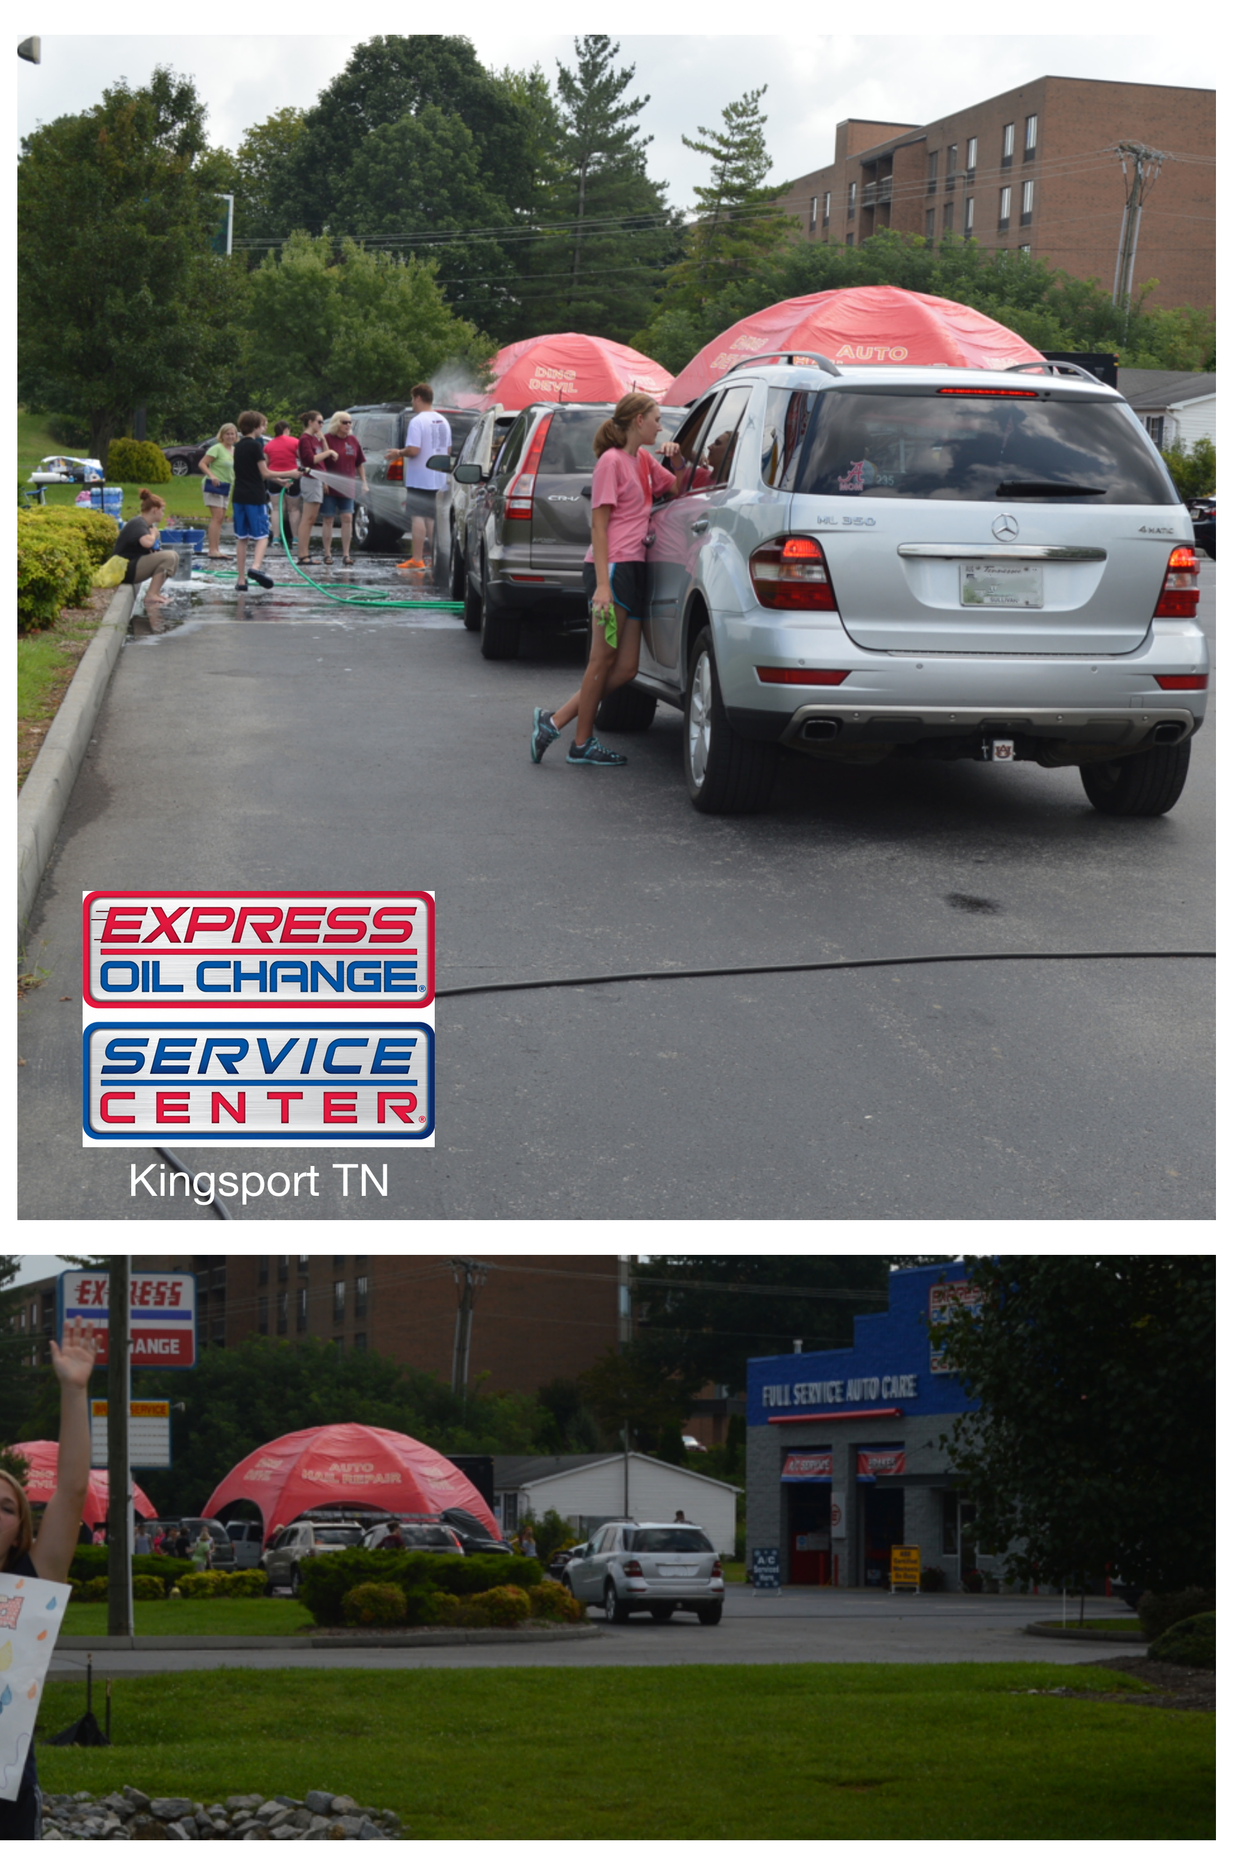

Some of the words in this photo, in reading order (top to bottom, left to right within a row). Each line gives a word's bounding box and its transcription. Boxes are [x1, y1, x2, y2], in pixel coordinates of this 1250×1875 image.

[836, 344, 908, 361] AUTO
[529, 378, 578, 394] DEVIL
[838, 482, 864, 491] MOM
[817, 515, 838, 526] ML
[842, 516, 877, 527] 350
[76, 1280, 183, 1306] EXRESS
[762, 1384, 792, 1407] FULL
[793, 1380, 845, 1406] SERVICE
[846, 1376, 880, 1402] AUTO
[881, 1373, 918, 1400] CARE
[329, 1462, 374, 1473] AUTO
[301, 1469, 340, 1484] HAIL
[342, 1471, 402, 1485] REPAIR
